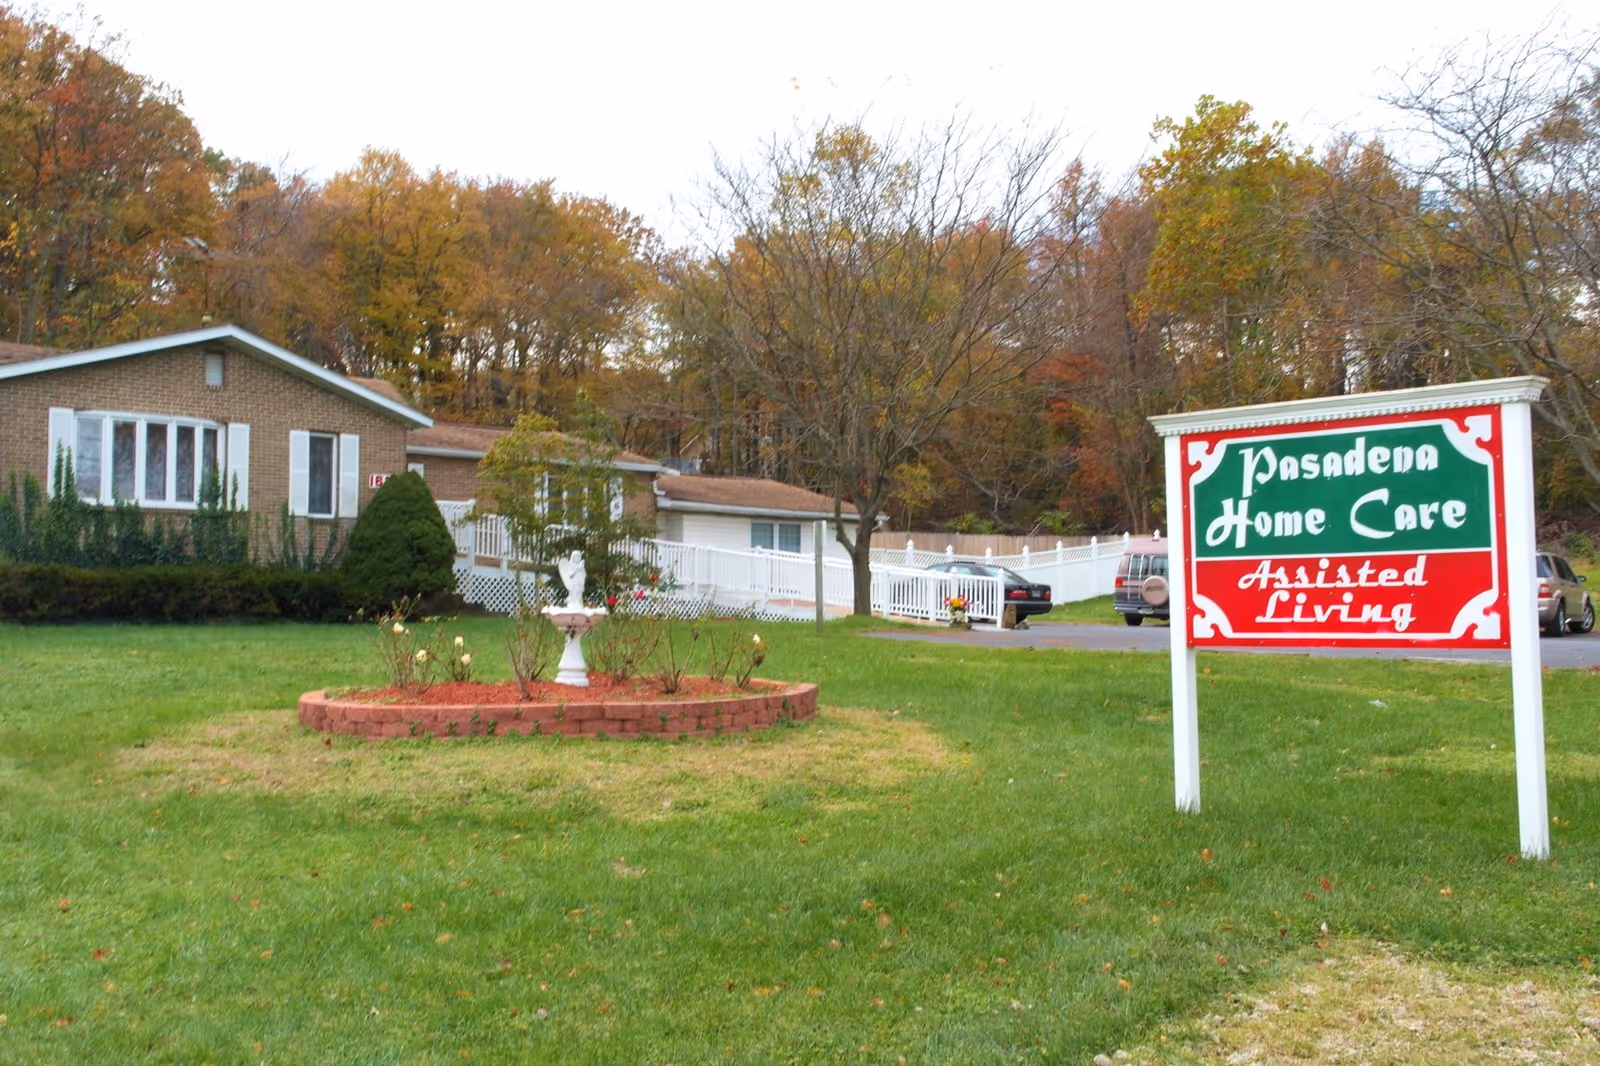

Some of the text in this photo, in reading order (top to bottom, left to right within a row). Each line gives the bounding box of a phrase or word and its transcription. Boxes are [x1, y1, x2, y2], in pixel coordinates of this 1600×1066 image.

[1238, 436, 1439, 498] Pasadena
[1205, 487, 1467, 549] Home Care
[1238, 554, 1429, 591] Assisted
[1255, 589, 1417, 632] Living
